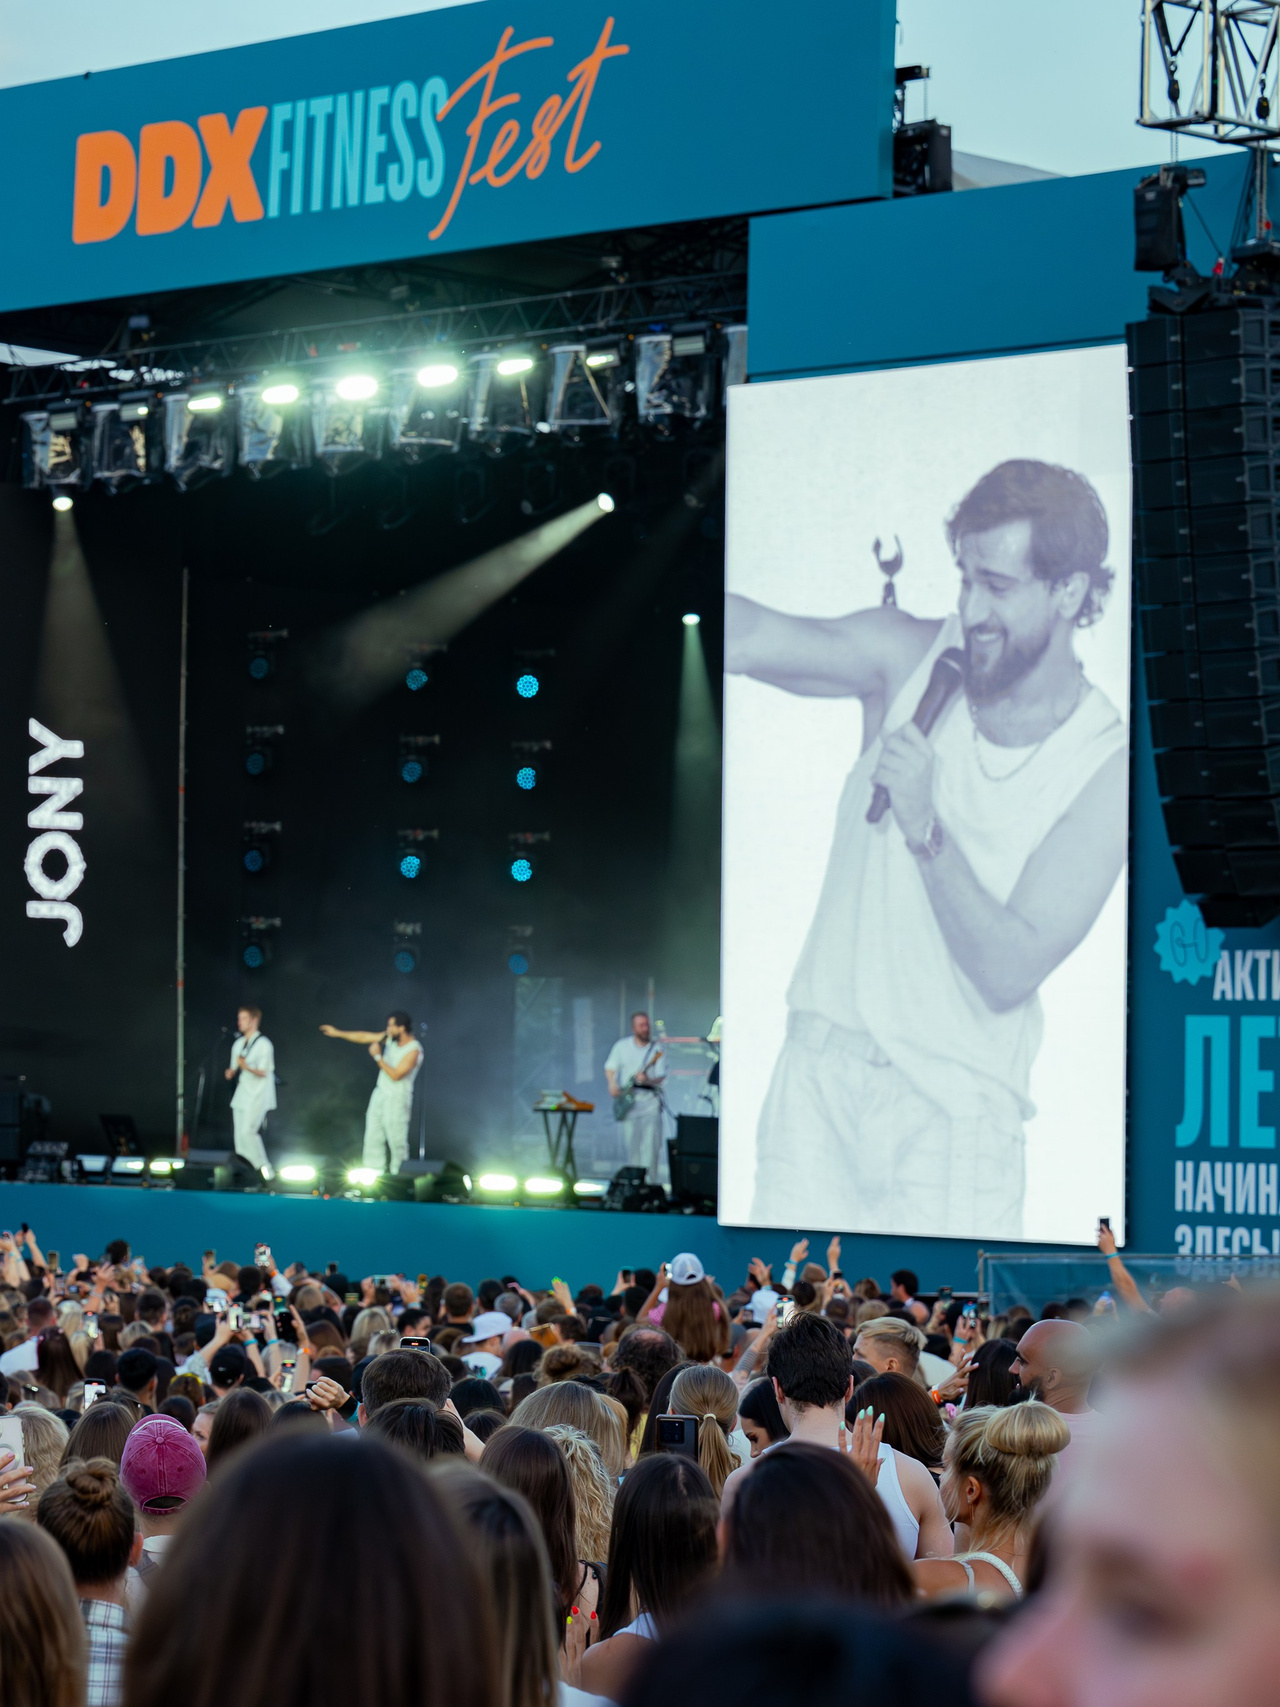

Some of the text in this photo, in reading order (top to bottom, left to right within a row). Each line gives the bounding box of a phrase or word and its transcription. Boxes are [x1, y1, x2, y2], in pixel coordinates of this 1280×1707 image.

[267, 76, 449, 219] FITNESS
[428, 16, 630, 241] Fest
[23, 717, 87, 948] JONY
[1174, 1014, 1280, 1150] ЛЕ
[1174, 1160, 1280, 1215] НАЧИН
